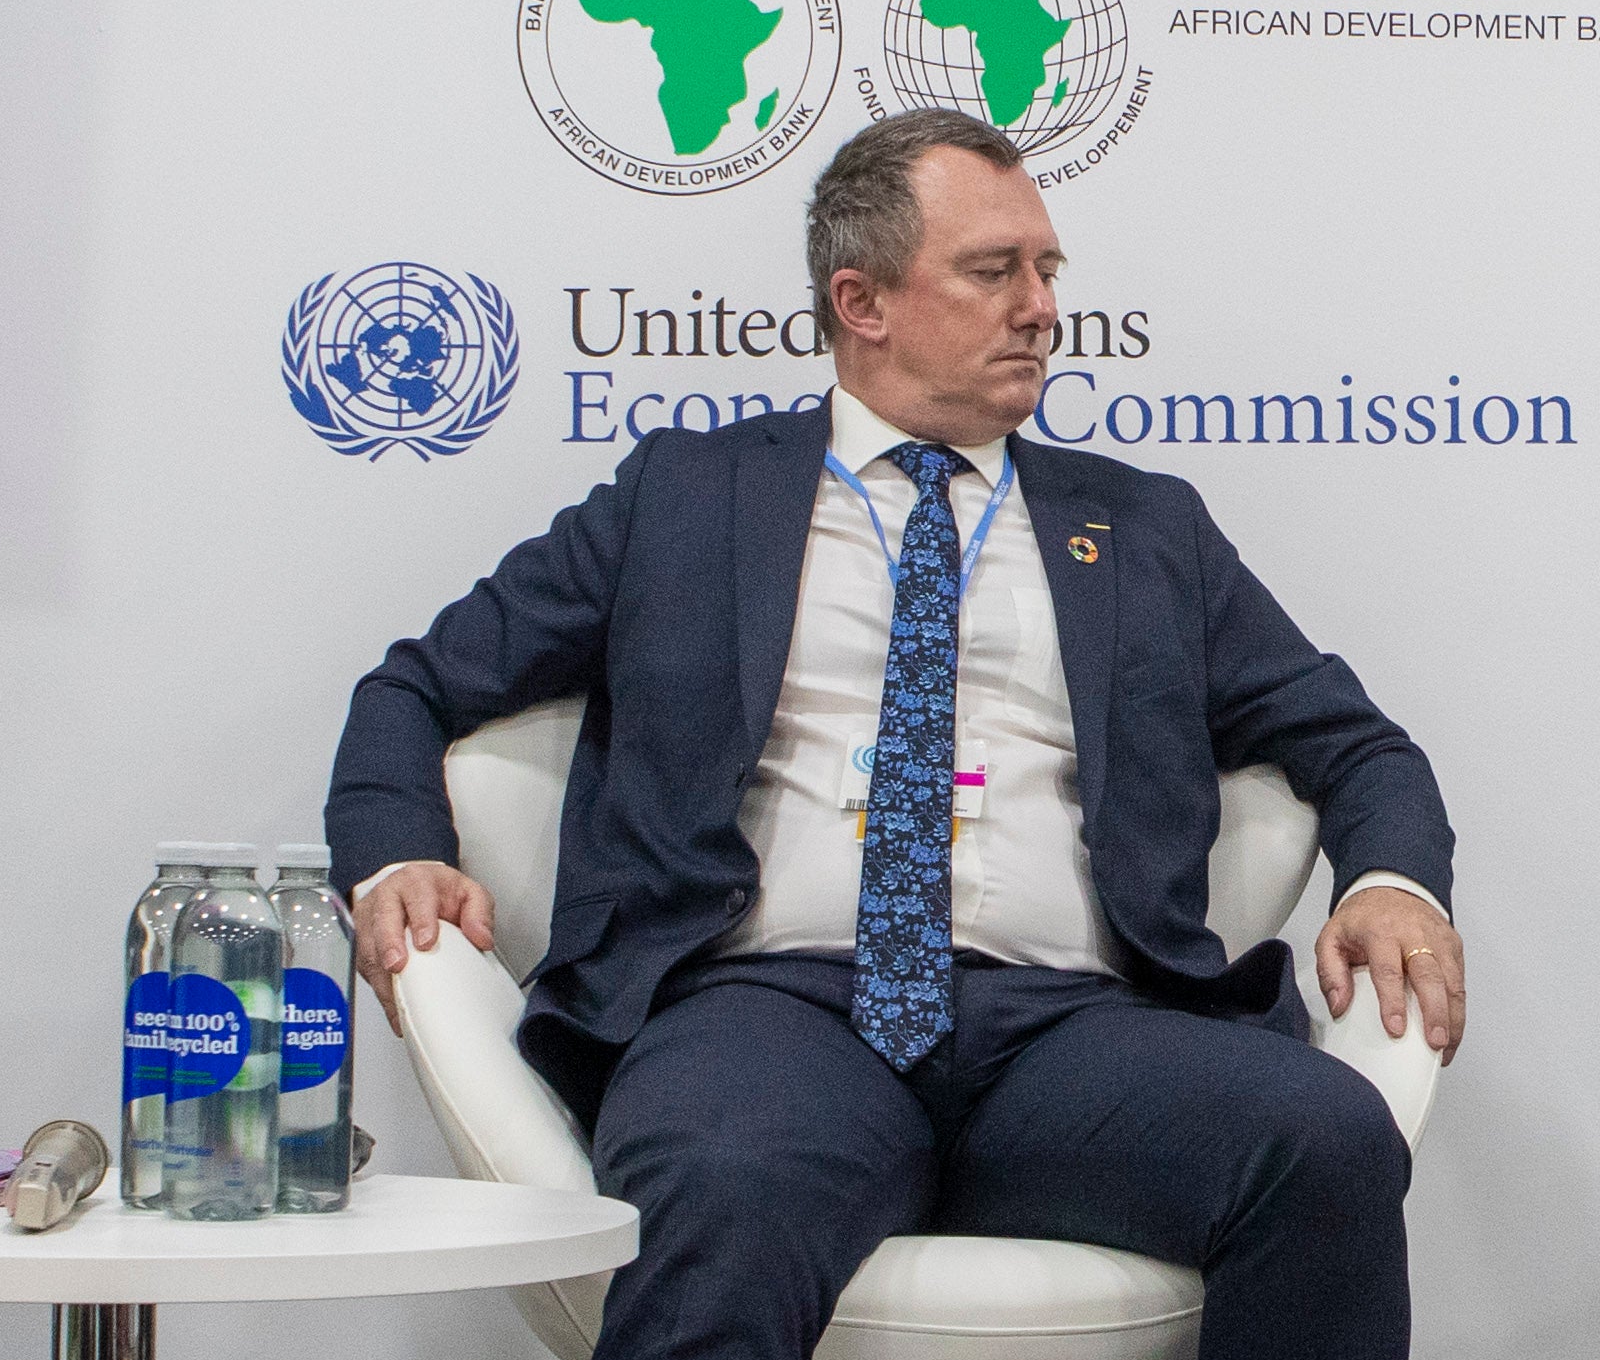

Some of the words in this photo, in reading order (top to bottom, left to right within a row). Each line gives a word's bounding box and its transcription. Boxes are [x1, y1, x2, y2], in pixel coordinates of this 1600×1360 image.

[1168, 9, 1312, 37] AFRICAN
[1323, 10, 1567, 41] DEVELOPMENT
[548, 107, 621, 171] AFRICAN
[623, 146, 769, 187] DEVELOPMENT
[769, 103, 815, 153] BANK
[1033, 370, 1578, 447] Commission
[186, 1011, 241, 1032] 100%
[285, 1026, 346, 1050] again
